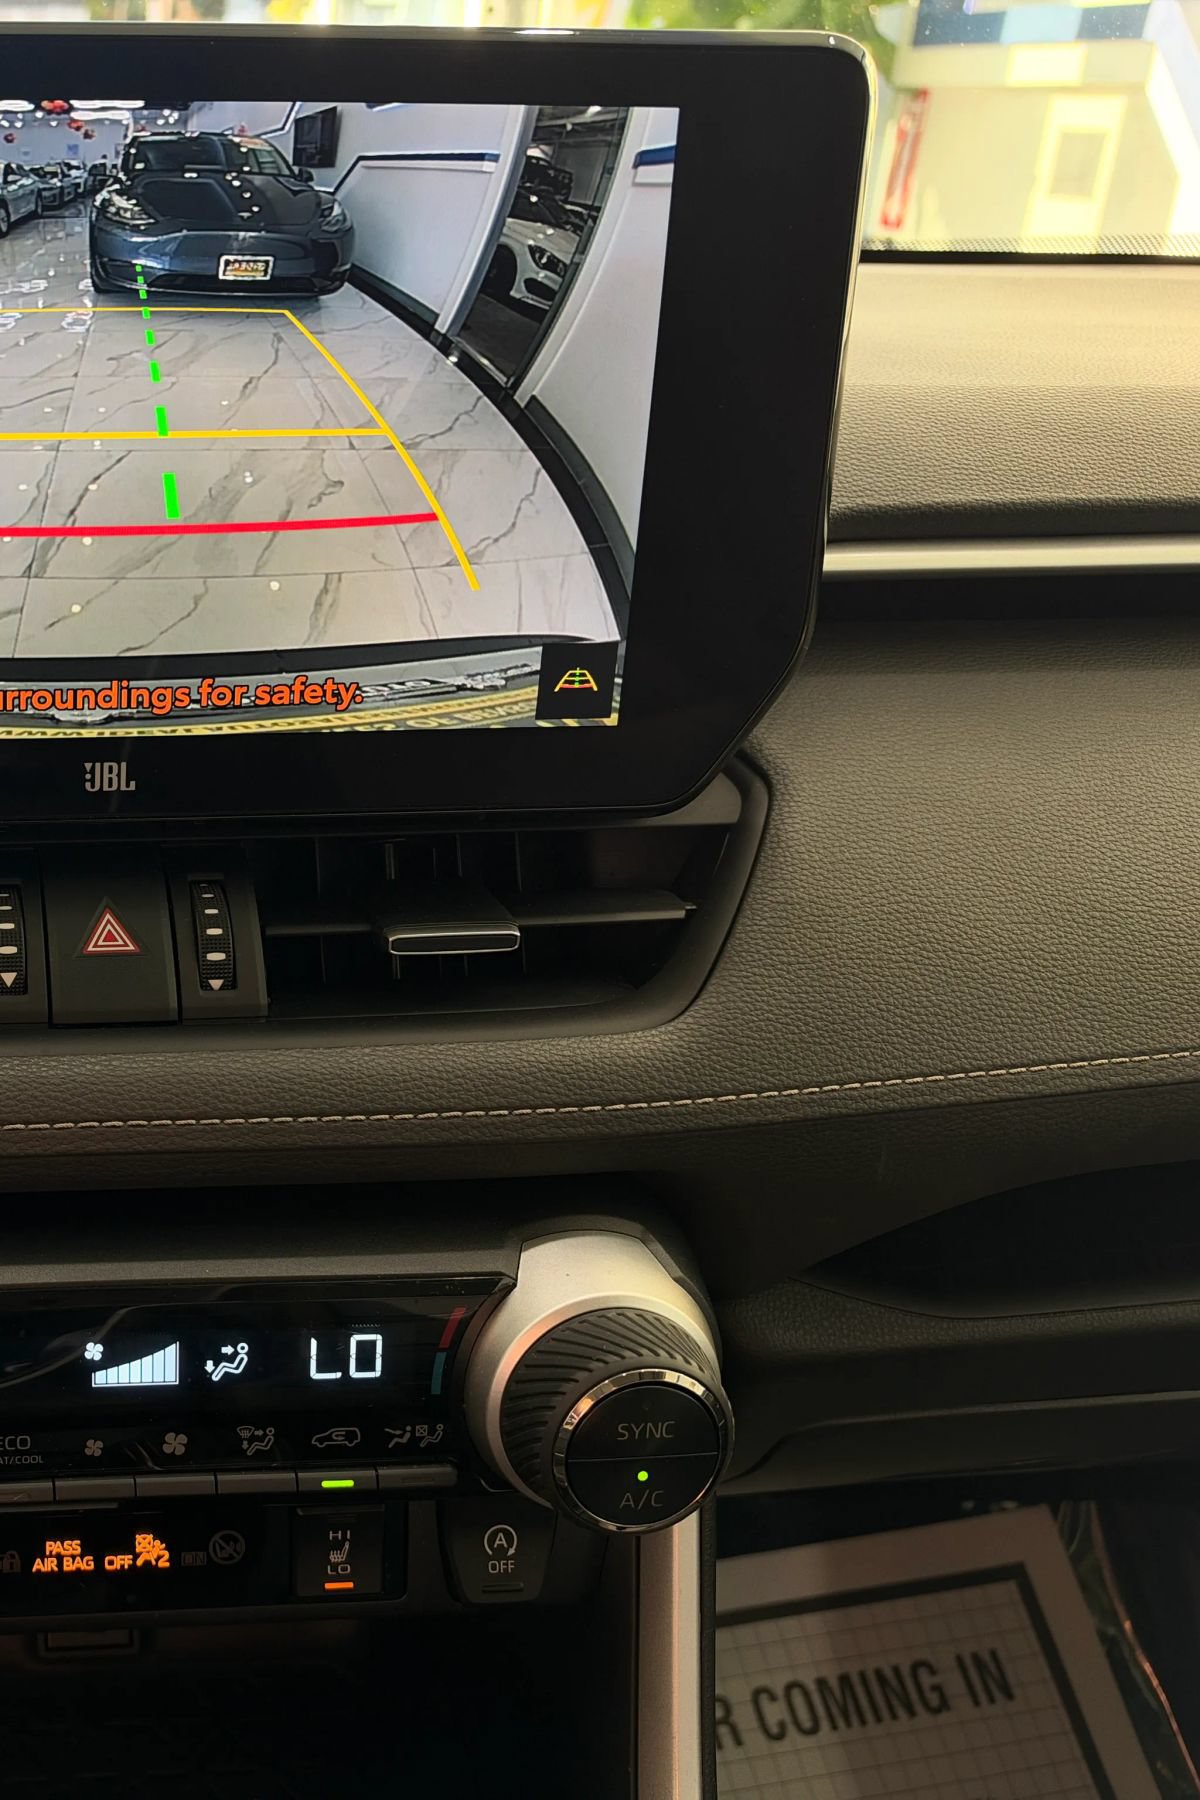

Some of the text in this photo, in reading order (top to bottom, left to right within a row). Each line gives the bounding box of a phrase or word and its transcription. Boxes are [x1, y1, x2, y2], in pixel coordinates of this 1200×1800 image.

[198, 677, 248, 707] for
[254, 675, 364, 711] safety.
[83, 761, 136, 792] JBL
[308, 1332, 385, 1381] LO
[616, 1420, 676, 1441] SYNC
[619, 1490, 664, 1510] A/C
[329, 1529, 351, 1541] HI
[45, 1540, 82, 1555] PASS
[32, 1557, 59, 1572] AIR
[63, 1556, 95, 1571] BAG
[104, 1554, 133, 1570] OFF
[327, 1564, 351, 1575] LO
[488, 1560, 516, 1574] OFF
[751, 1658, 951, 1742] COMING
[955, 1647, 1016, 1708] IN
